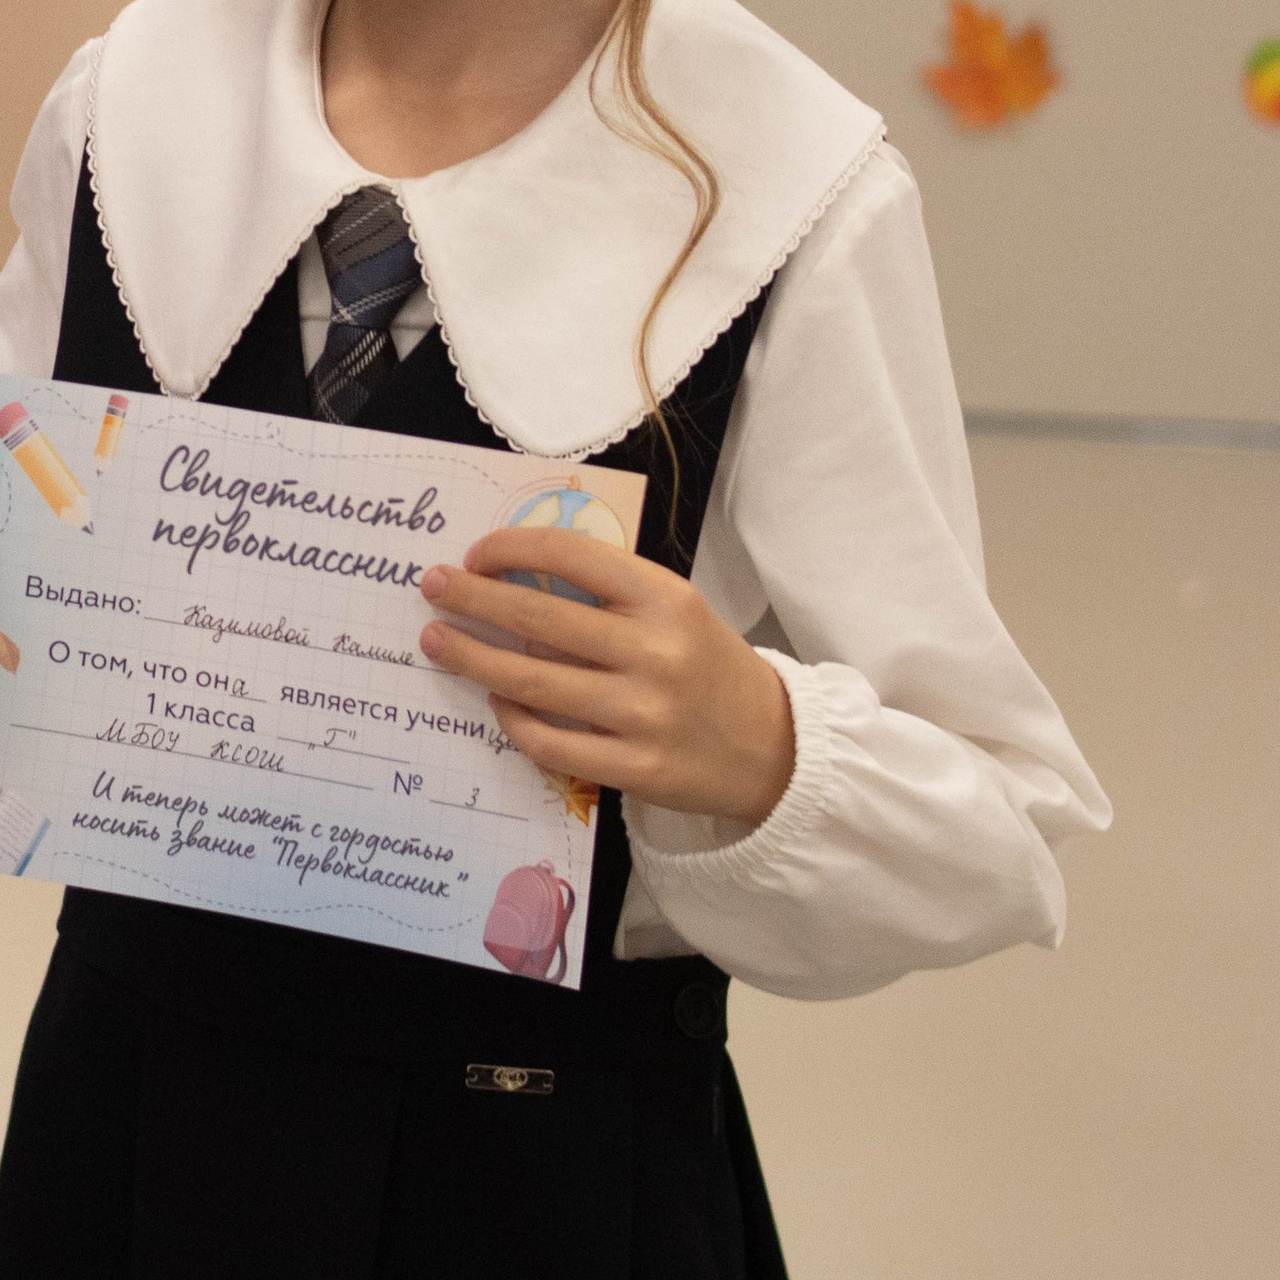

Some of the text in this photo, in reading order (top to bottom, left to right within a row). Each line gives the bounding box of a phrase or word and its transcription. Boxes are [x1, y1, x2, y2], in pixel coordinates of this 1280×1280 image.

[159, 444, 447, 534] Свидетельство
[152, 509, 424, 588] первоклассник
[24, 574, 142, 615] Выдано:
[183, 603, 311, 644] Казимовой
[48, 639, 71, 664] О
[78, 650, 134, 679] том,
[143, 660, 188, 684] что
[280, 685, 398, 723] является
[95, 717, 181, 753] МБОУ
[146, 691, 157, 716] 1
[164, 701, 256, 733] класса
[392, 770, 481, 809] № 3
[72, 811, 161, 842] носить
[166, 819, 257, 861] звание
[91, 770, 455, 865] И теперь может с гордостью
